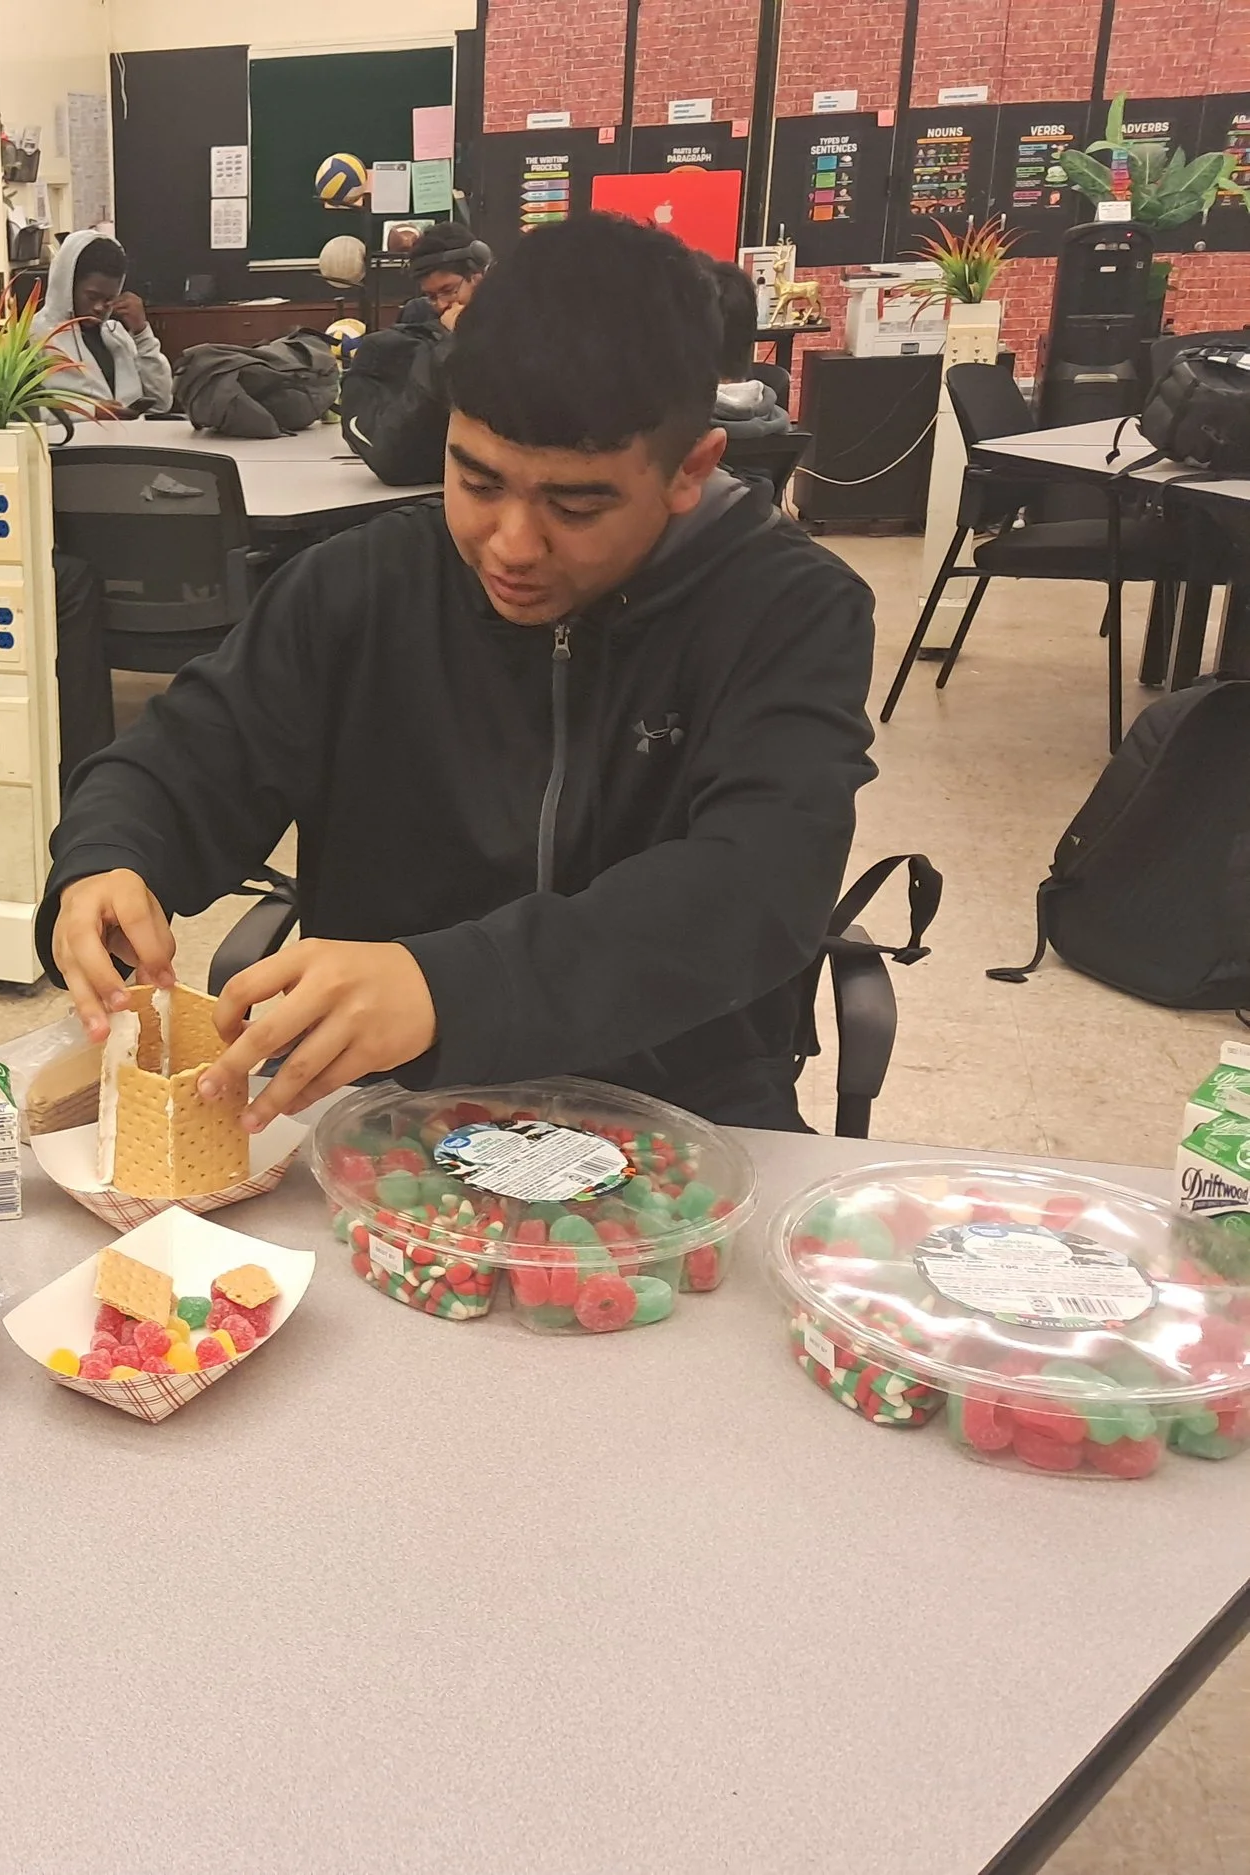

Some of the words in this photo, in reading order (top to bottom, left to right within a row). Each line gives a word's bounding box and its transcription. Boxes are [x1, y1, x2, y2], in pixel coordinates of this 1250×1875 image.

[927, 127, 963, 137] NOUNS
[1030, 125, 1065, 136] VERBS
[1121, 122, 1169, 134] ADVERBS
[819, 137, 840, 145] TYPES
[810, 143, 858, 155] SENTENCES
[539, 155, 569, 164] WRITING
[667, 154, 712, 163] PARAGRAPH
[1181, 1167, 1248, 1201] Driftwood
